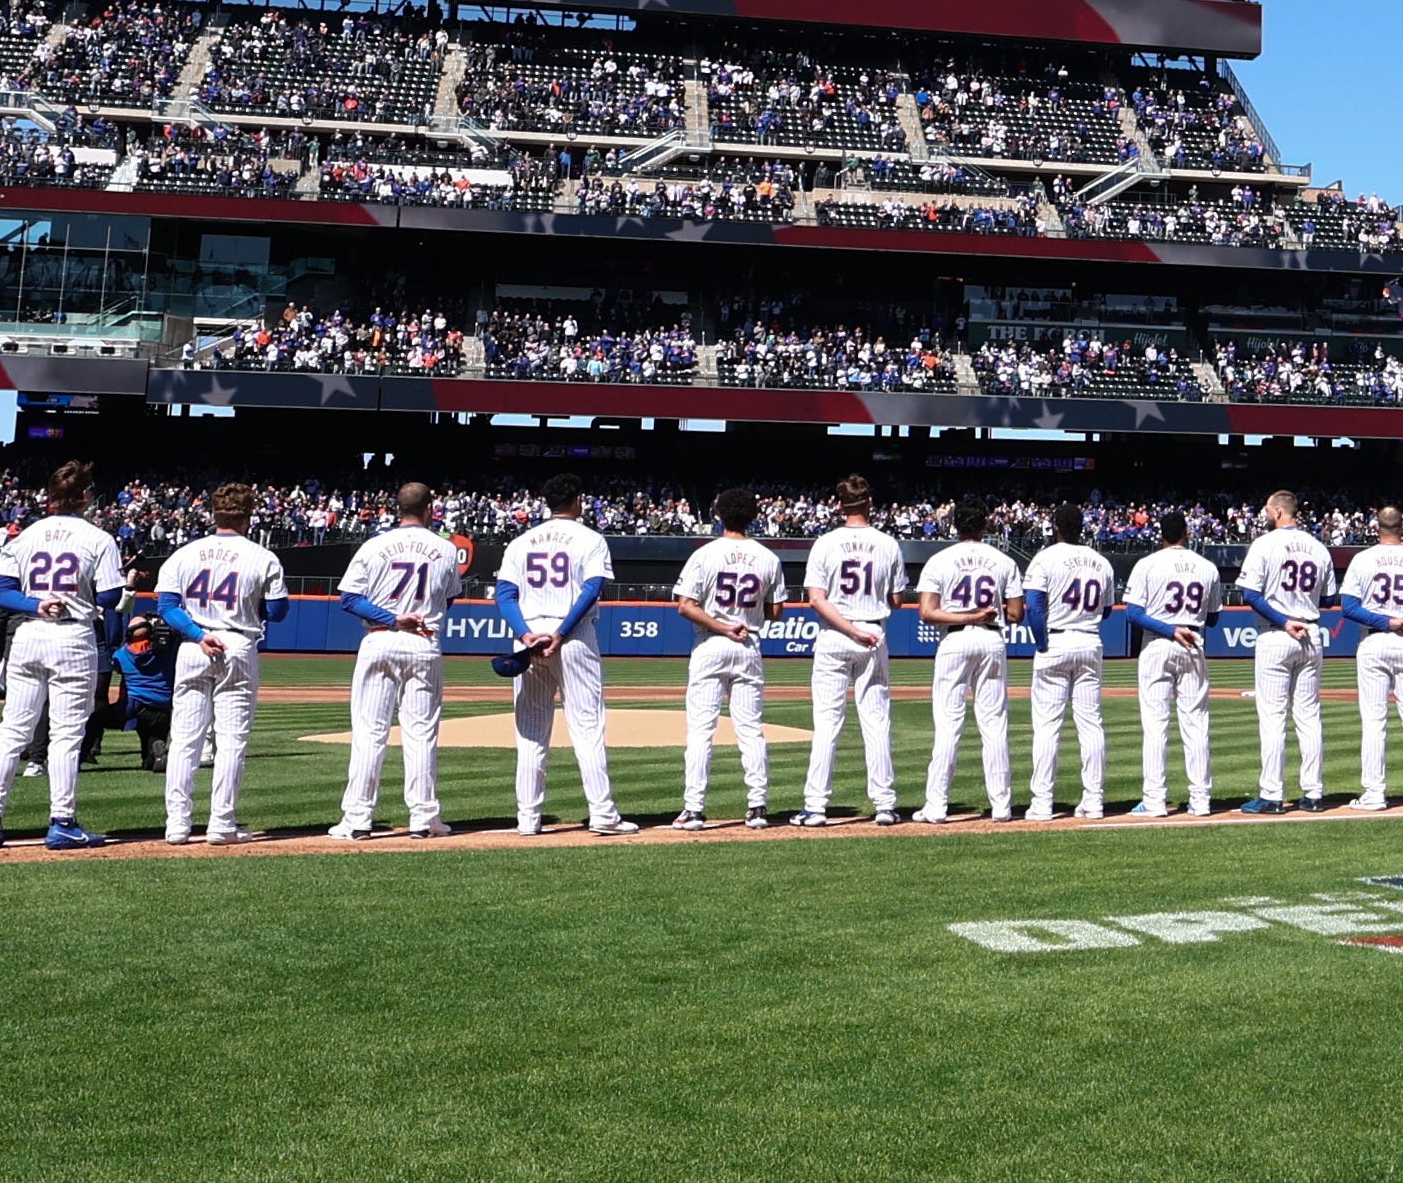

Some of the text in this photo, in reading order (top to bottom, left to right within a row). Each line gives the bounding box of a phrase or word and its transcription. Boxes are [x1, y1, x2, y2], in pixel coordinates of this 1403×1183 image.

[987, 325, 1028, 340] THE
[45, 529, 74, 543] BATY
[379, 540, 443, 562] REID-FOLEY
[529, 532, 574, 546] MANAEA
[840, 542, 876, 555] TONKIN
[29, 551, 80, 592] 22
[199, 548, 240, 563] BADER
[526, 551, 570, 588] 59
[186, 569, 239, 610] 44
[390, 562, 429, 600] 71
[715, 572, 761, 609] 52
[840, 560, 873, 596] 51
[951, 575, 995, 608] 46
[1281, 559, 1318, 593] 38
[1062, 578, 1101, 612] 40
[1165, 581, 1204, 614] 39
[447, 619, 513, 638] HYU
[620, 621, 658, 638] 358
[786, 642, 808, 652] Car
